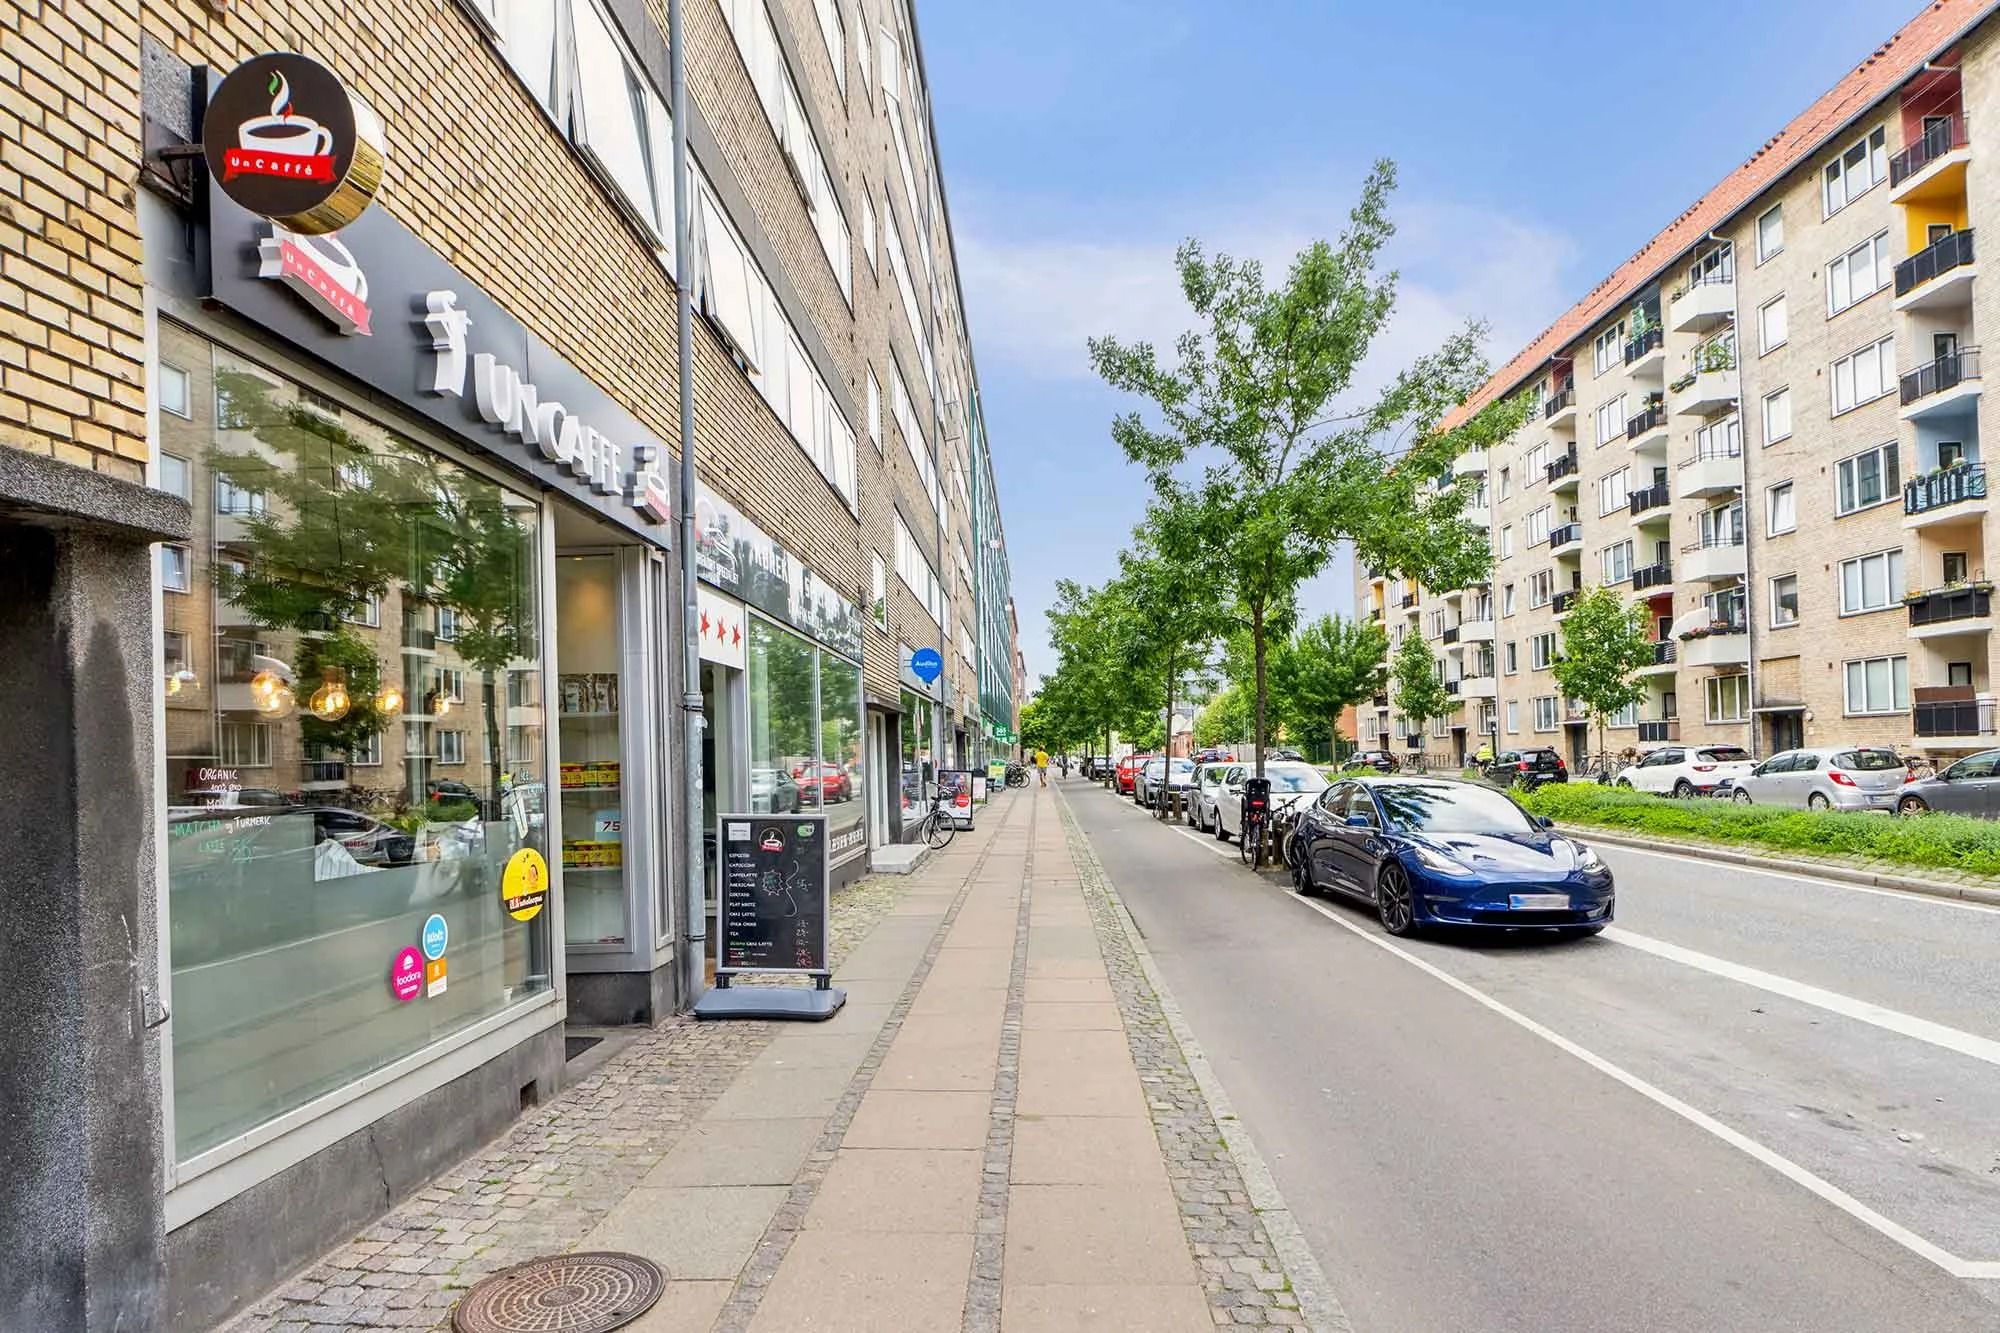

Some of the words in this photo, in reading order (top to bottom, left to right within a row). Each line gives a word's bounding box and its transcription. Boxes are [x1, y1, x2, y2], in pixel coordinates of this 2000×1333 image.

[200, 768, 239, 780] ORGANIC
[233, 815, 271, 830] TURMERIC
[603, 821, 620, 831] 75
